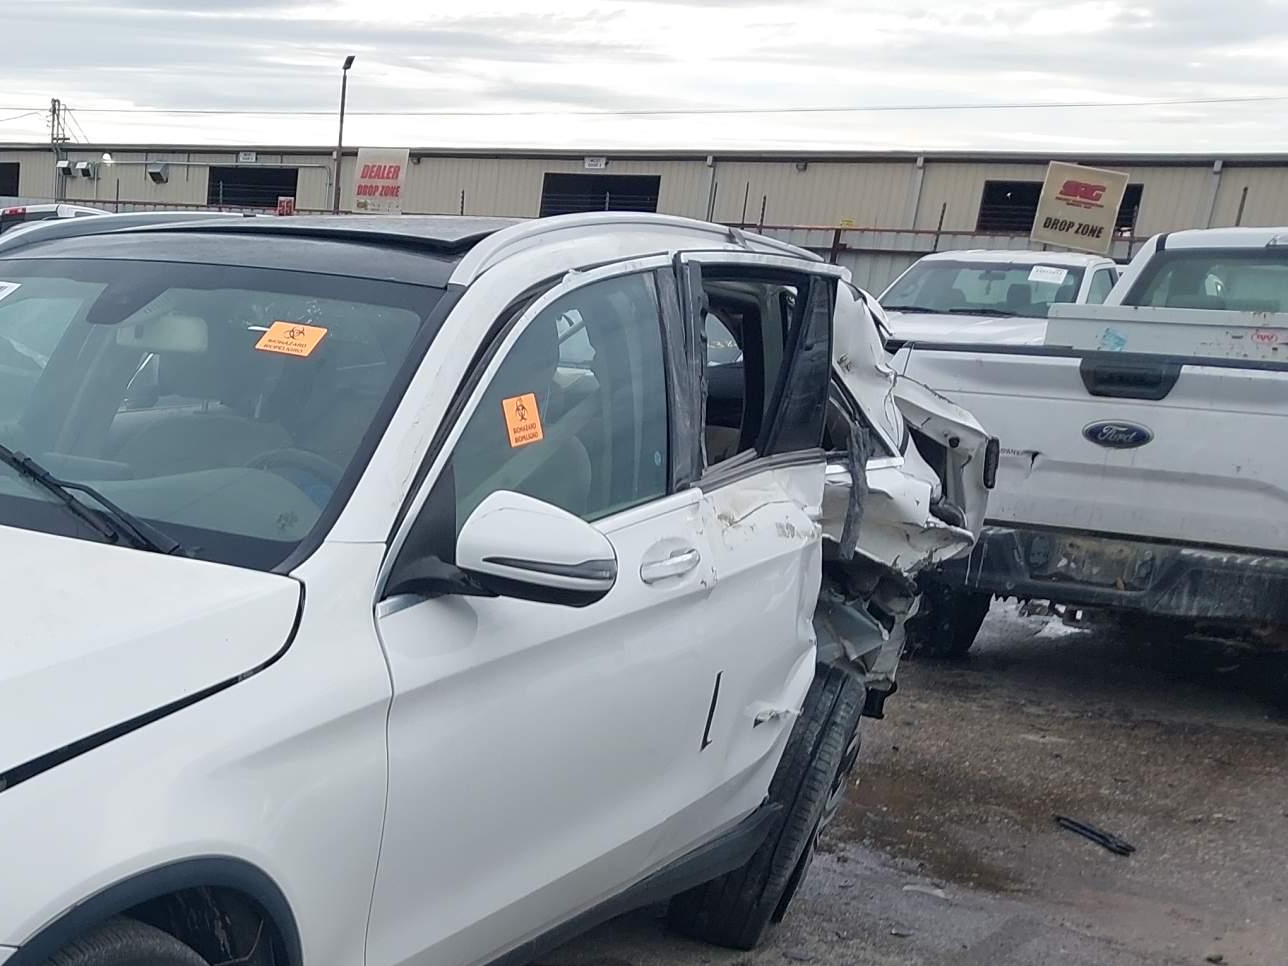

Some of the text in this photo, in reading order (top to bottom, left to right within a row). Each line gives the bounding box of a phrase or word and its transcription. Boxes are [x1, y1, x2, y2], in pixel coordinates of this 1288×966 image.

[360, 164, 401, 179] DEALER
[356, 184, 401, 198] DROP ZONE
[1043, 216, 1105, 239] DROP ZONE
[1097, 424, 1138, 443] Ford
